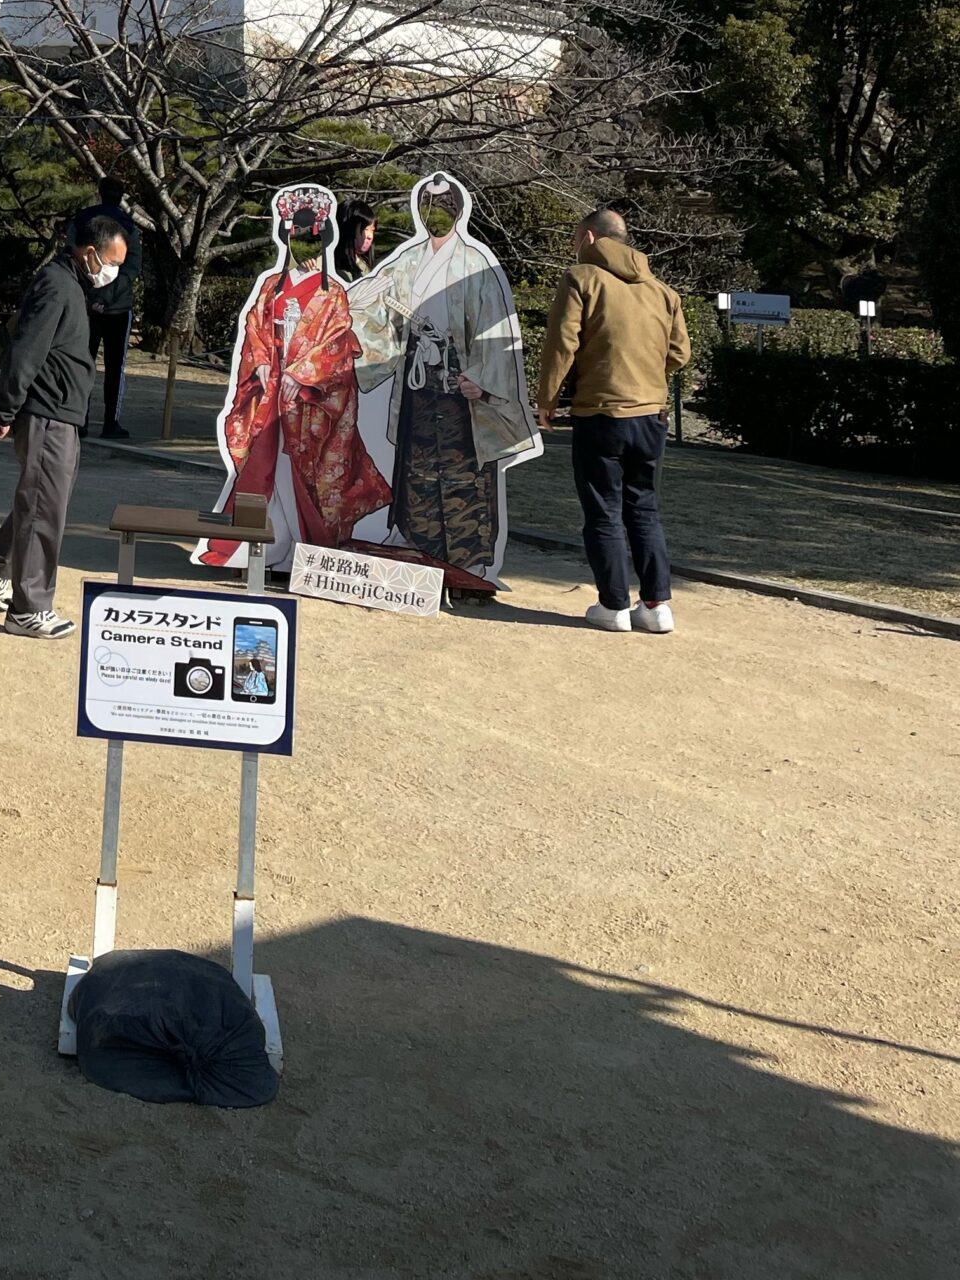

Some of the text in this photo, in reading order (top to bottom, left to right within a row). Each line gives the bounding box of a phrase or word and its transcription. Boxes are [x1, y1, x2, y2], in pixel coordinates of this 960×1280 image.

[303, 572, 425, 608] #HimejiCastle
[103, 607, 222, 630] カメラスタンド
[101, 629, 223, 650] Camera Stand
